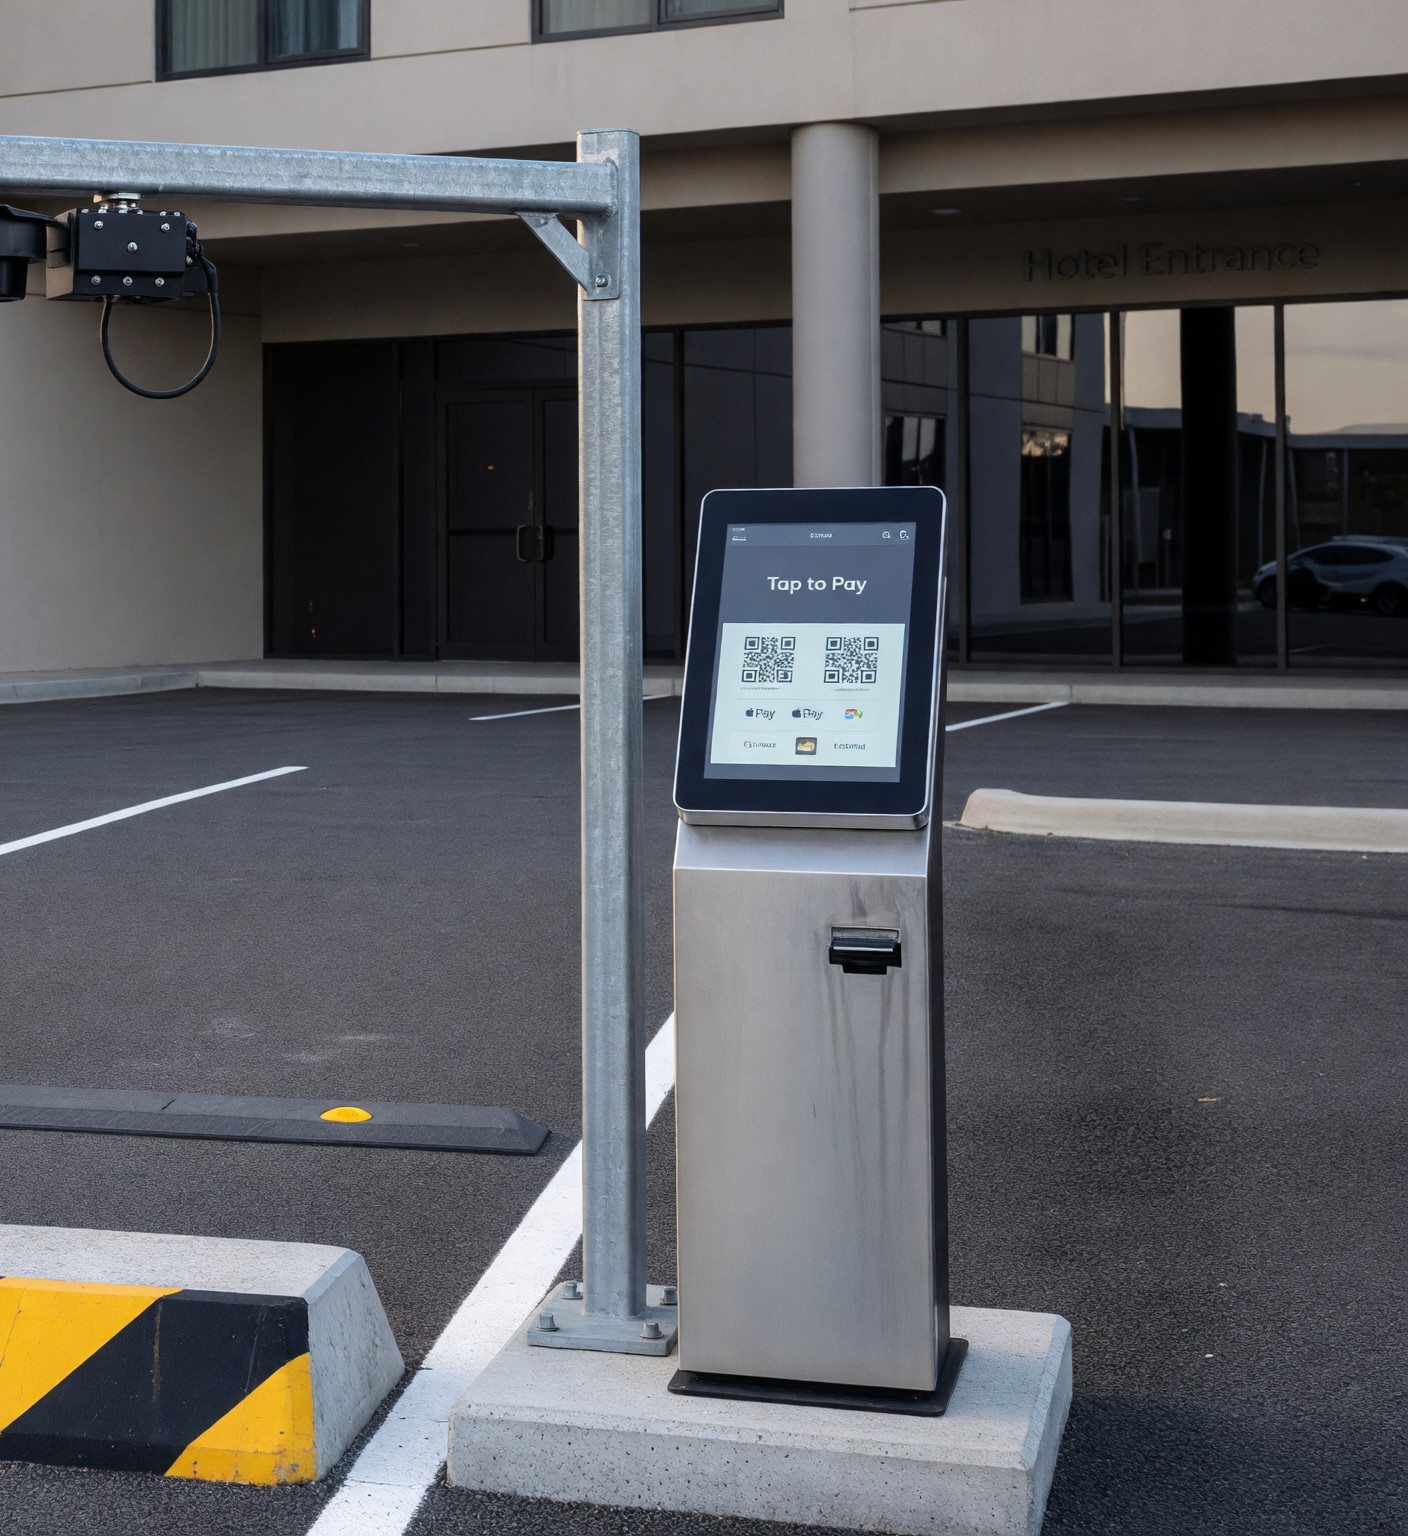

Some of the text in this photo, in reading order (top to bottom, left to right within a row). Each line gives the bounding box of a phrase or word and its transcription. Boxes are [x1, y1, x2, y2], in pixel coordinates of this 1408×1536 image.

[1025, 241, 1321, 281] Hotel Entrance
[767, 576, 867, 595] Tap to Pay
[755, 708, 776, 720] Pay
